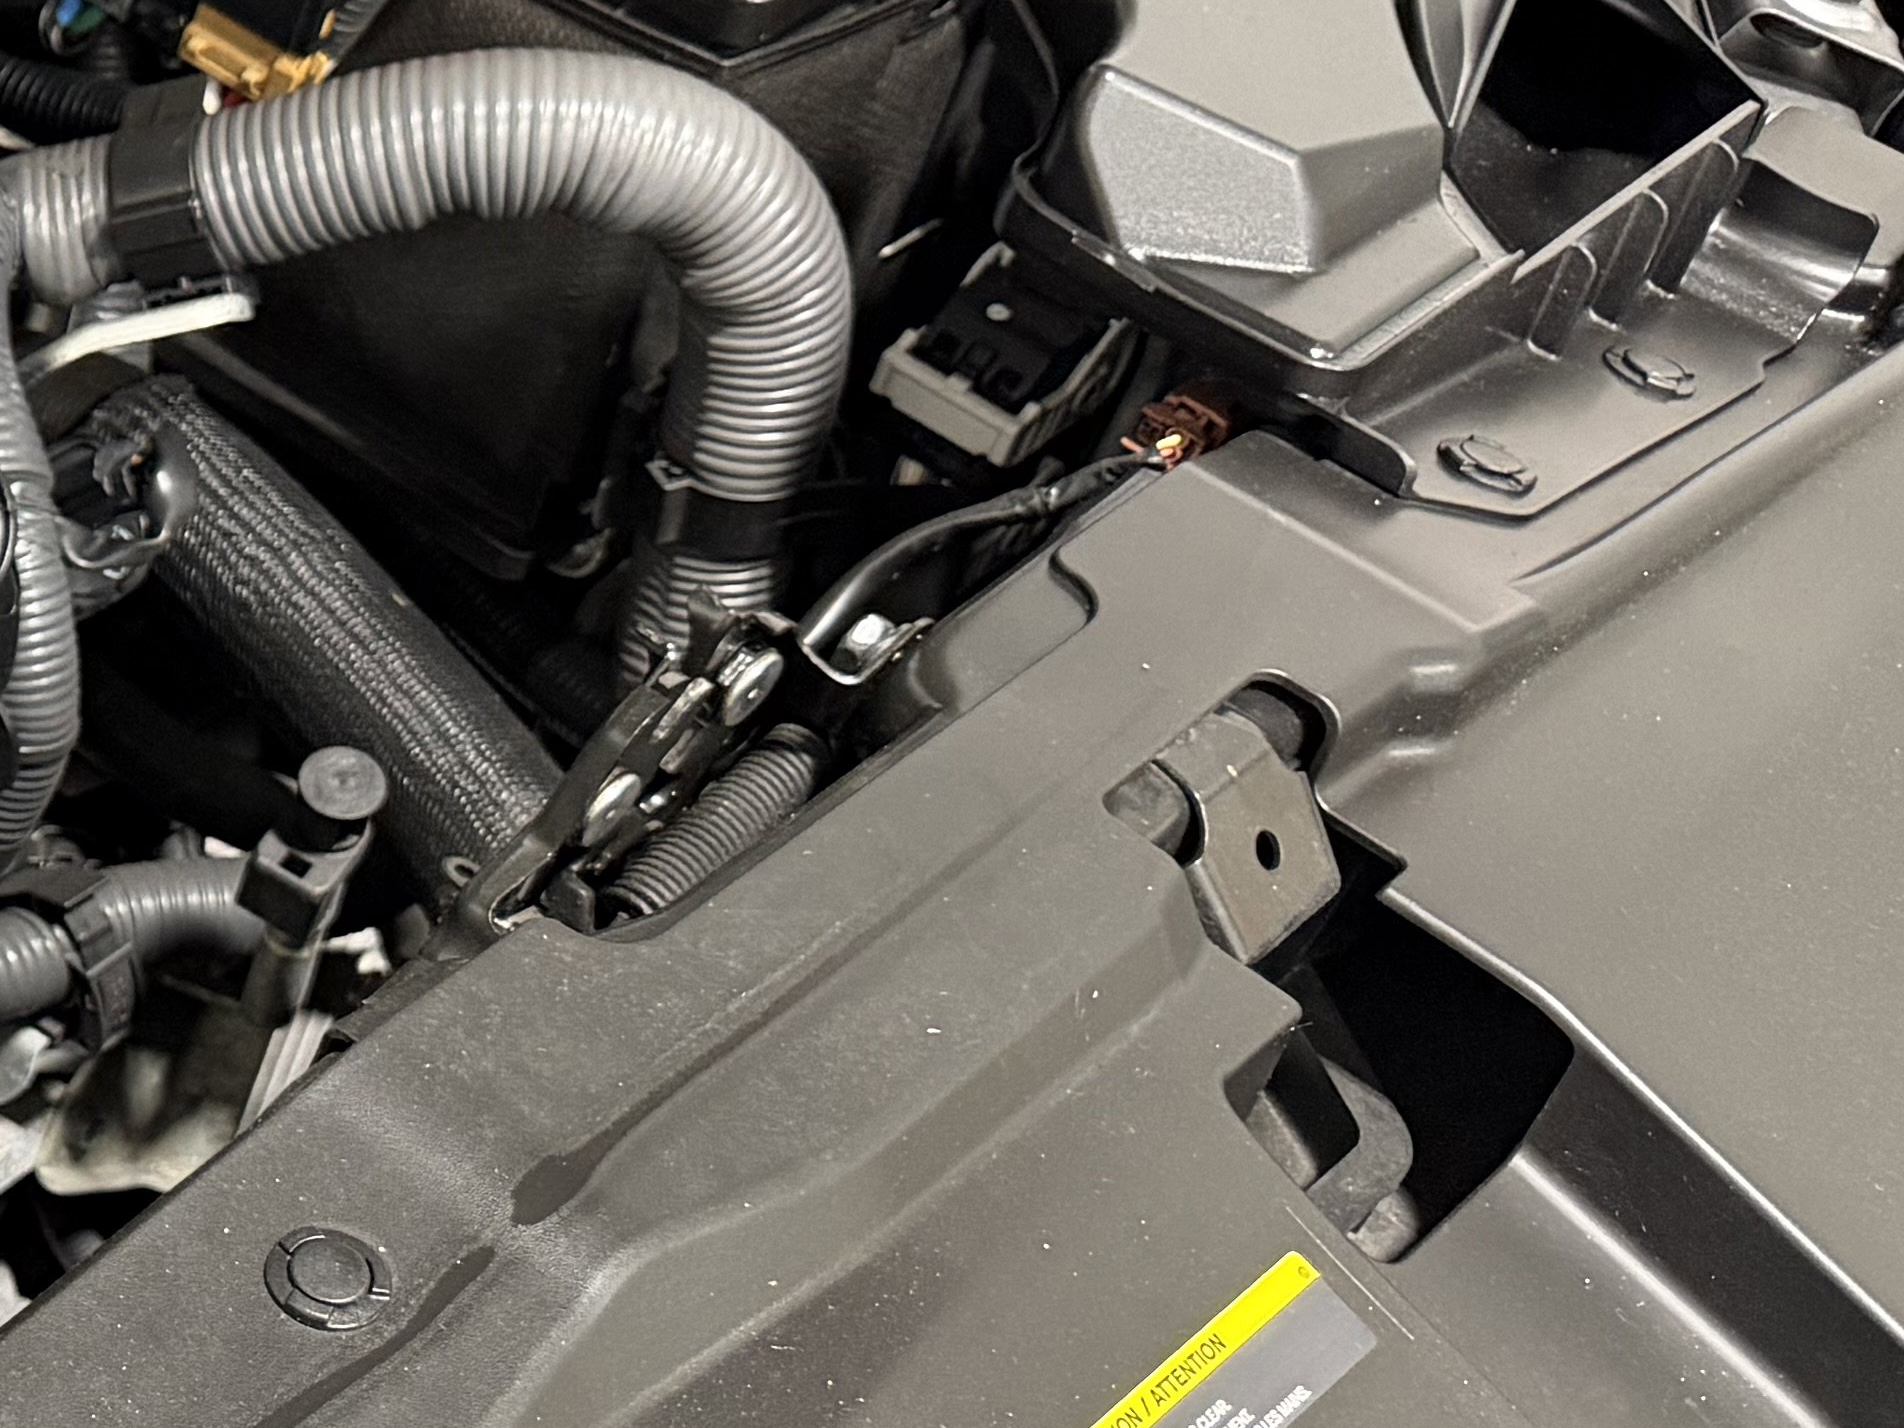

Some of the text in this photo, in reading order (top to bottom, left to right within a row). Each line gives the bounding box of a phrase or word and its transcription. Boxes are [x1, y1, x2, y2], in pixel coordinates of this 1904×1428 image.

[1140, 1397, 1149, 1413] /
[1150, 1333, 1226, 1407] ATTENTION
[1275, 1385, 1313, 1418] MAINS.
